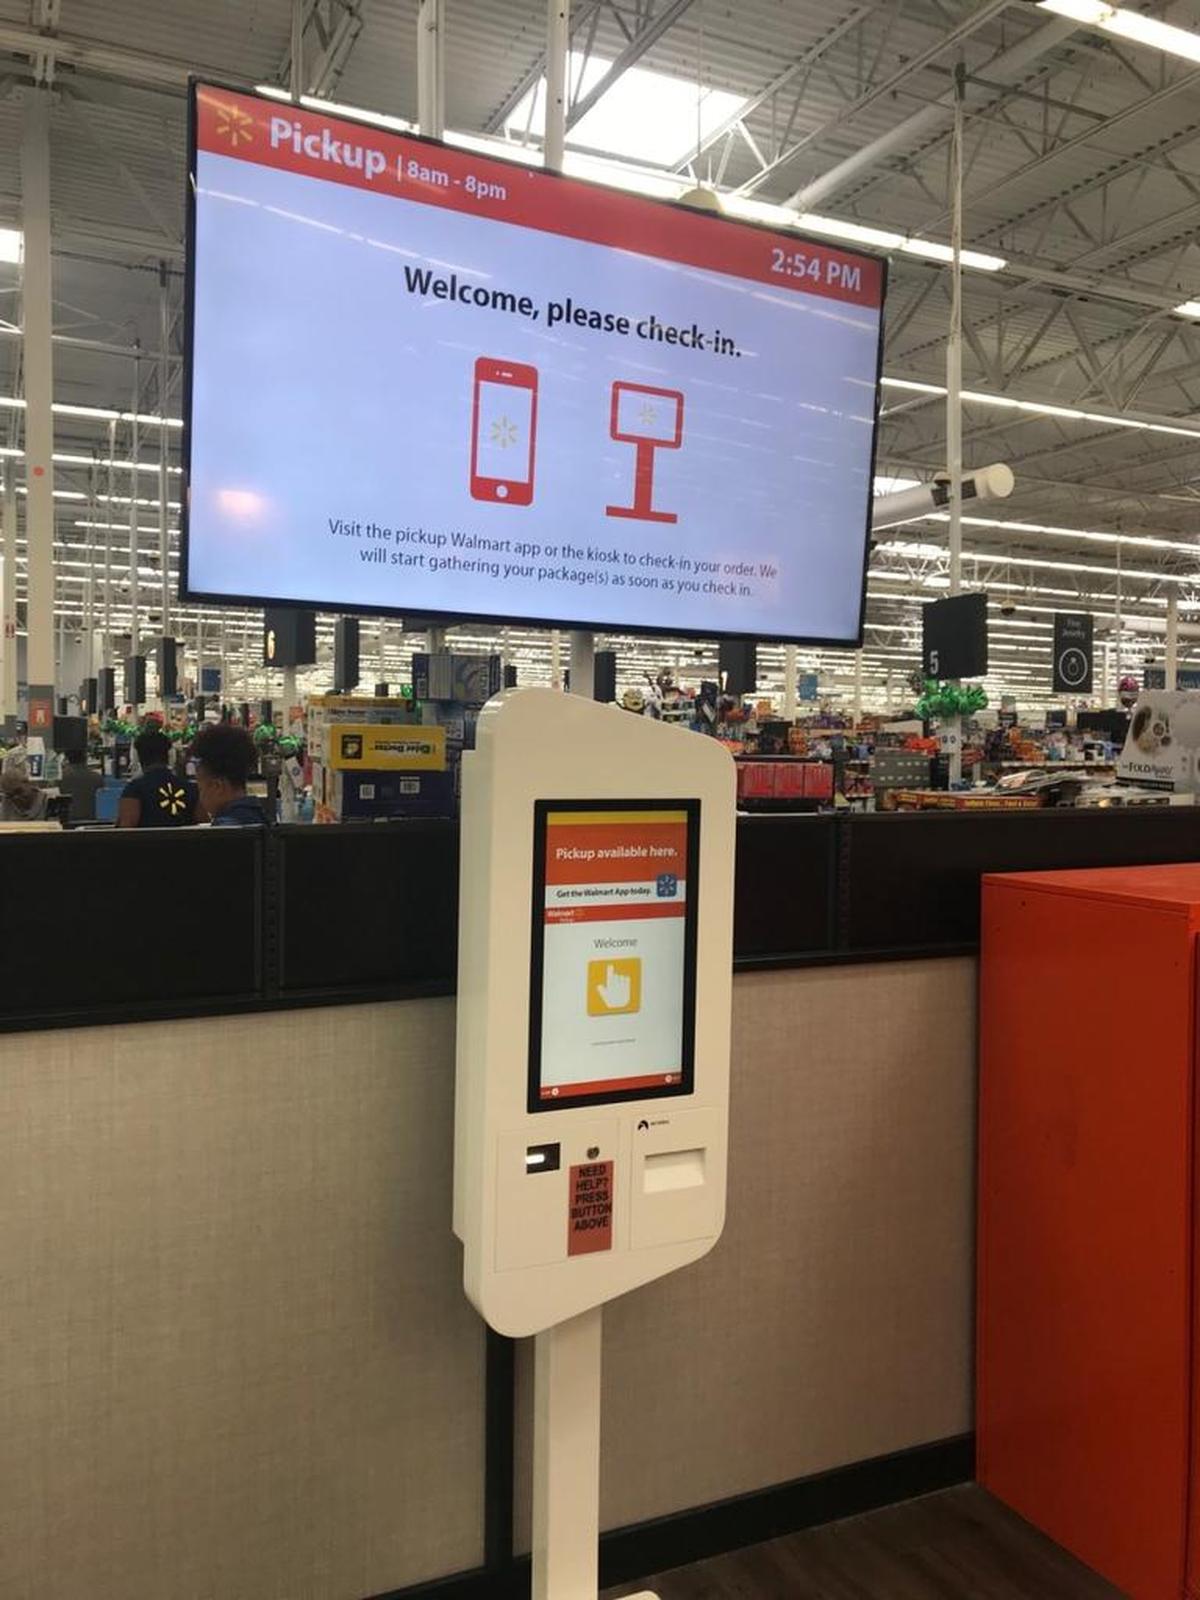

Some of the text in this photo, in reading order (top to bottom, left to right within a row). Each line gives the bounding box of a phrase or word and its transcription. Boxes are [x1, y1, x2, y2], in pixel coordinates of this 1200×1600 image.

[269, 116, 387, 180] Pickup
[407, 160, 449, 187] 8am
[465, 175, 506, 200] 8pm
[771, 247, 860, 292] 2:54 PM
[404, 266, 742, 358] Welcome, please check-in.
[329, 518, 778, 579] Visit the pickup Walmart app or the kiosk to check-in your order. We
[360, 548, 753, 597] will start gathering your package(s) as soon as you check in.
[930, 650, 939, 675] 5
[556, 845, 678, 861] Pickup available here.
[556, 888, 570, 898] Get
[571, 887, 583, 898] the
[584, 886, 613, 897] Walmart
[614, 885, 629, 898] App
[593, 937, 638, 949] Welcome
[579, 1164, 606, 1178] NEED
[576, 1177, 608, 1192] HELP?
[576, 1190, 609, 1205] PRESS
[570, 1202, 612, 1219] BUTTON
[574, 1215, 609, 1231] ABOVE
